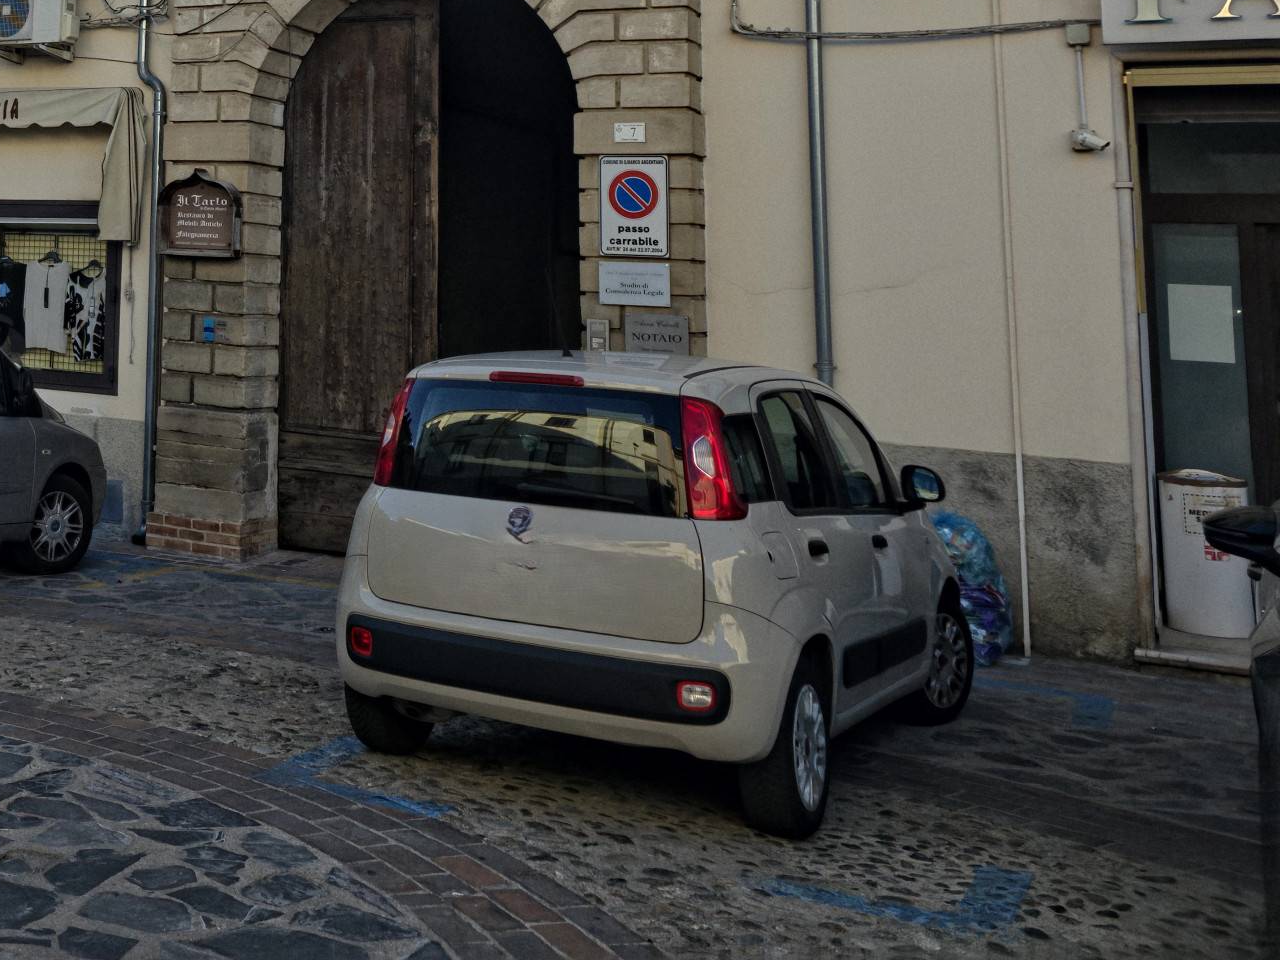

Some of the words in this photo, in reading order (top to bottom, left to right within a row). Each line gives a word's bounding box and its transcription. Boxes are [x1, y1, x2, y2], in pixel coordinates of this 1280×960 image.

[630, 127, 636, 137] 7
[617, 225, 650, 234] passo
[609, 237, 659, 246] carrabile
[632, 332, 682, 344] NOTAIO
